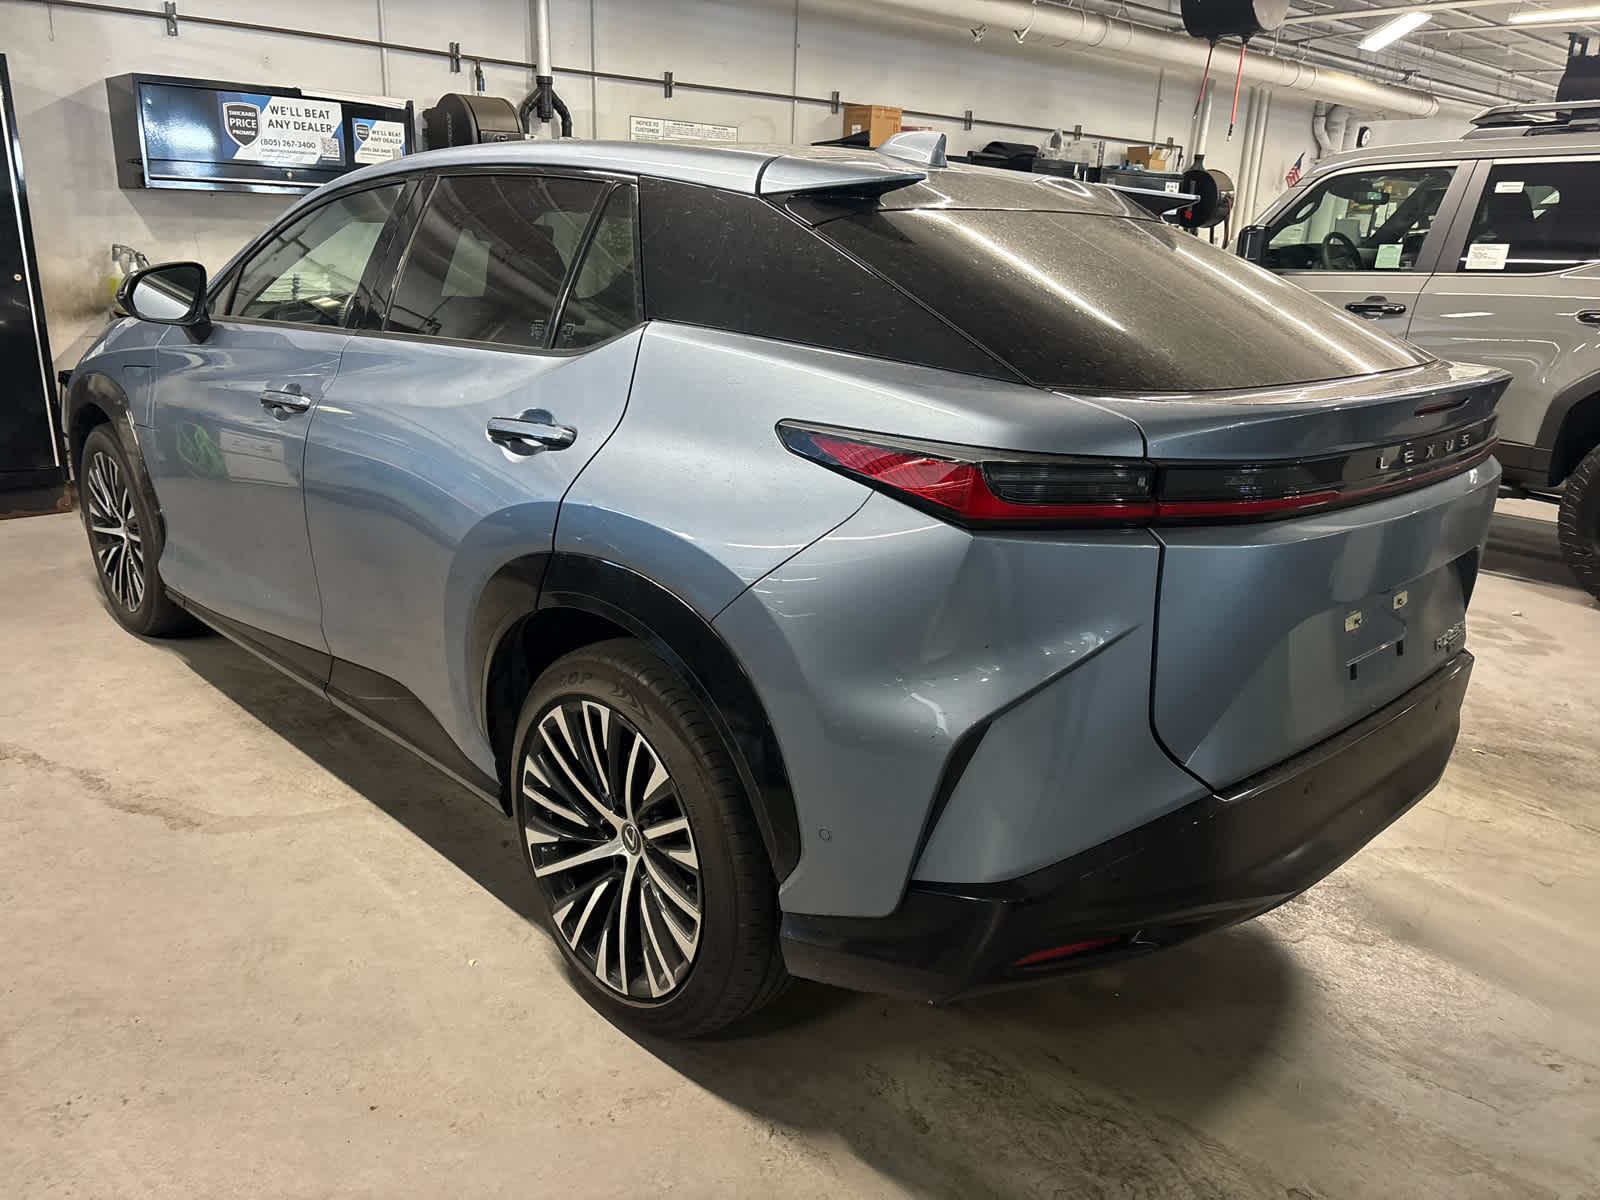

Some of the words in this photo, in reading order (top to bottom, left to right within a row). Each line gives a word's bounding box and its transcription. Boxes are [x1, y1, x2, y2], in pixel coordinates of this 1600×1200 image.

[269, 105, 301, 116] WE'LL
[304, 109, 330, 119] BEAT
[229, 118, 257, 129] PRICE
[267, 120, 290, 129] ANY
[260, 138, 281, 146] (805)
[282, 140, 316, 149] 267-3400
[1377, 434, 1470, 470] LEXUS
